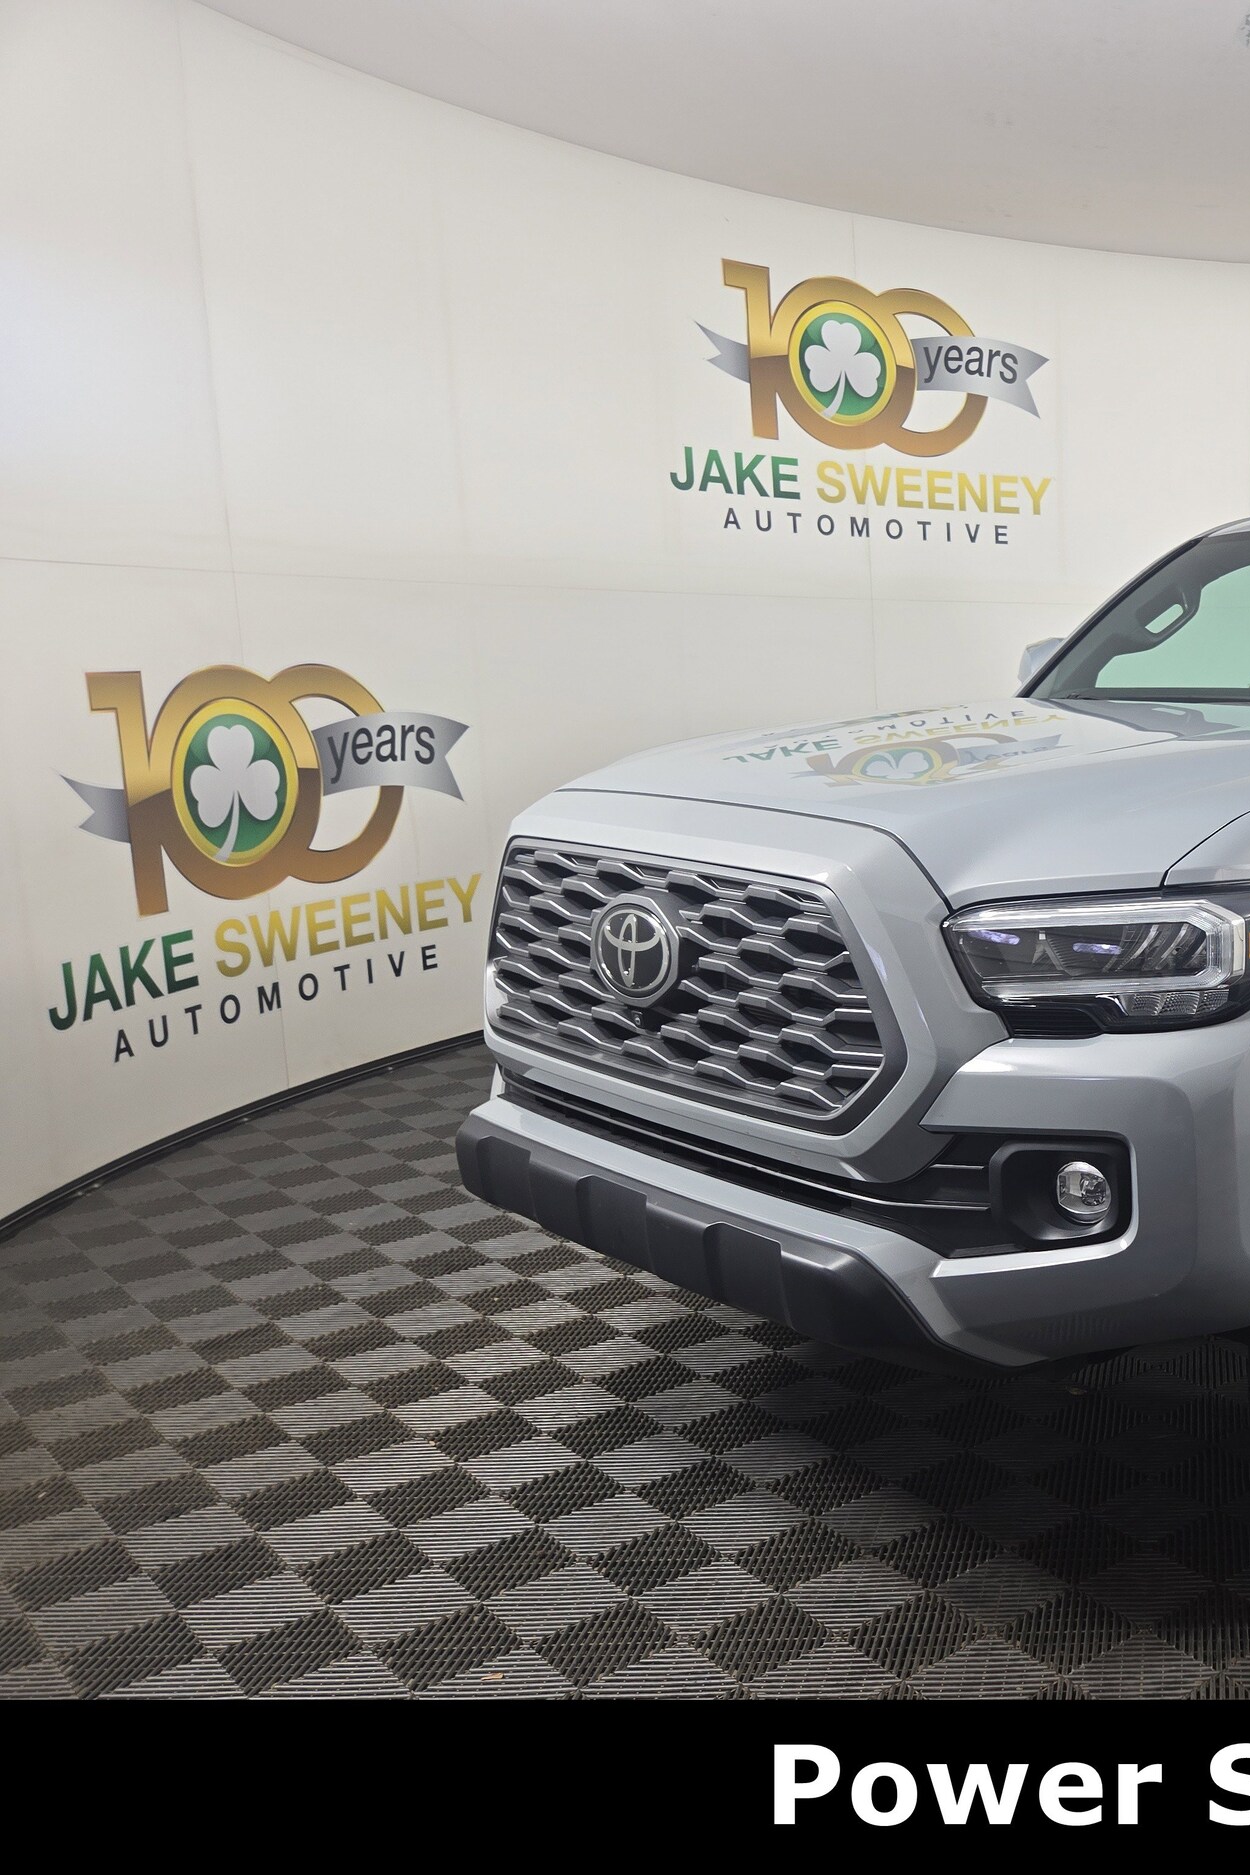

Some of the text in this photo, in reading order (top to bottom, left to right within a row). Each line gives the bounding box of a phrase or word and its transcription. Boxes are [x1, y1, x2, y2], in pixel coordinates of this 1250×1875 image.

[722, 258, 1018, 458] 100 years
[669, 446, 1052, 516] JAKE SWEENEY
[723, 507, 1009, 545] AUTOMOTIVE
[85, 663, 437, 918] 100 years
[48, 873, 482, 1031] JAKE SWEENEY
[114, 944, 439, 1063] AUTOMOTIVE
